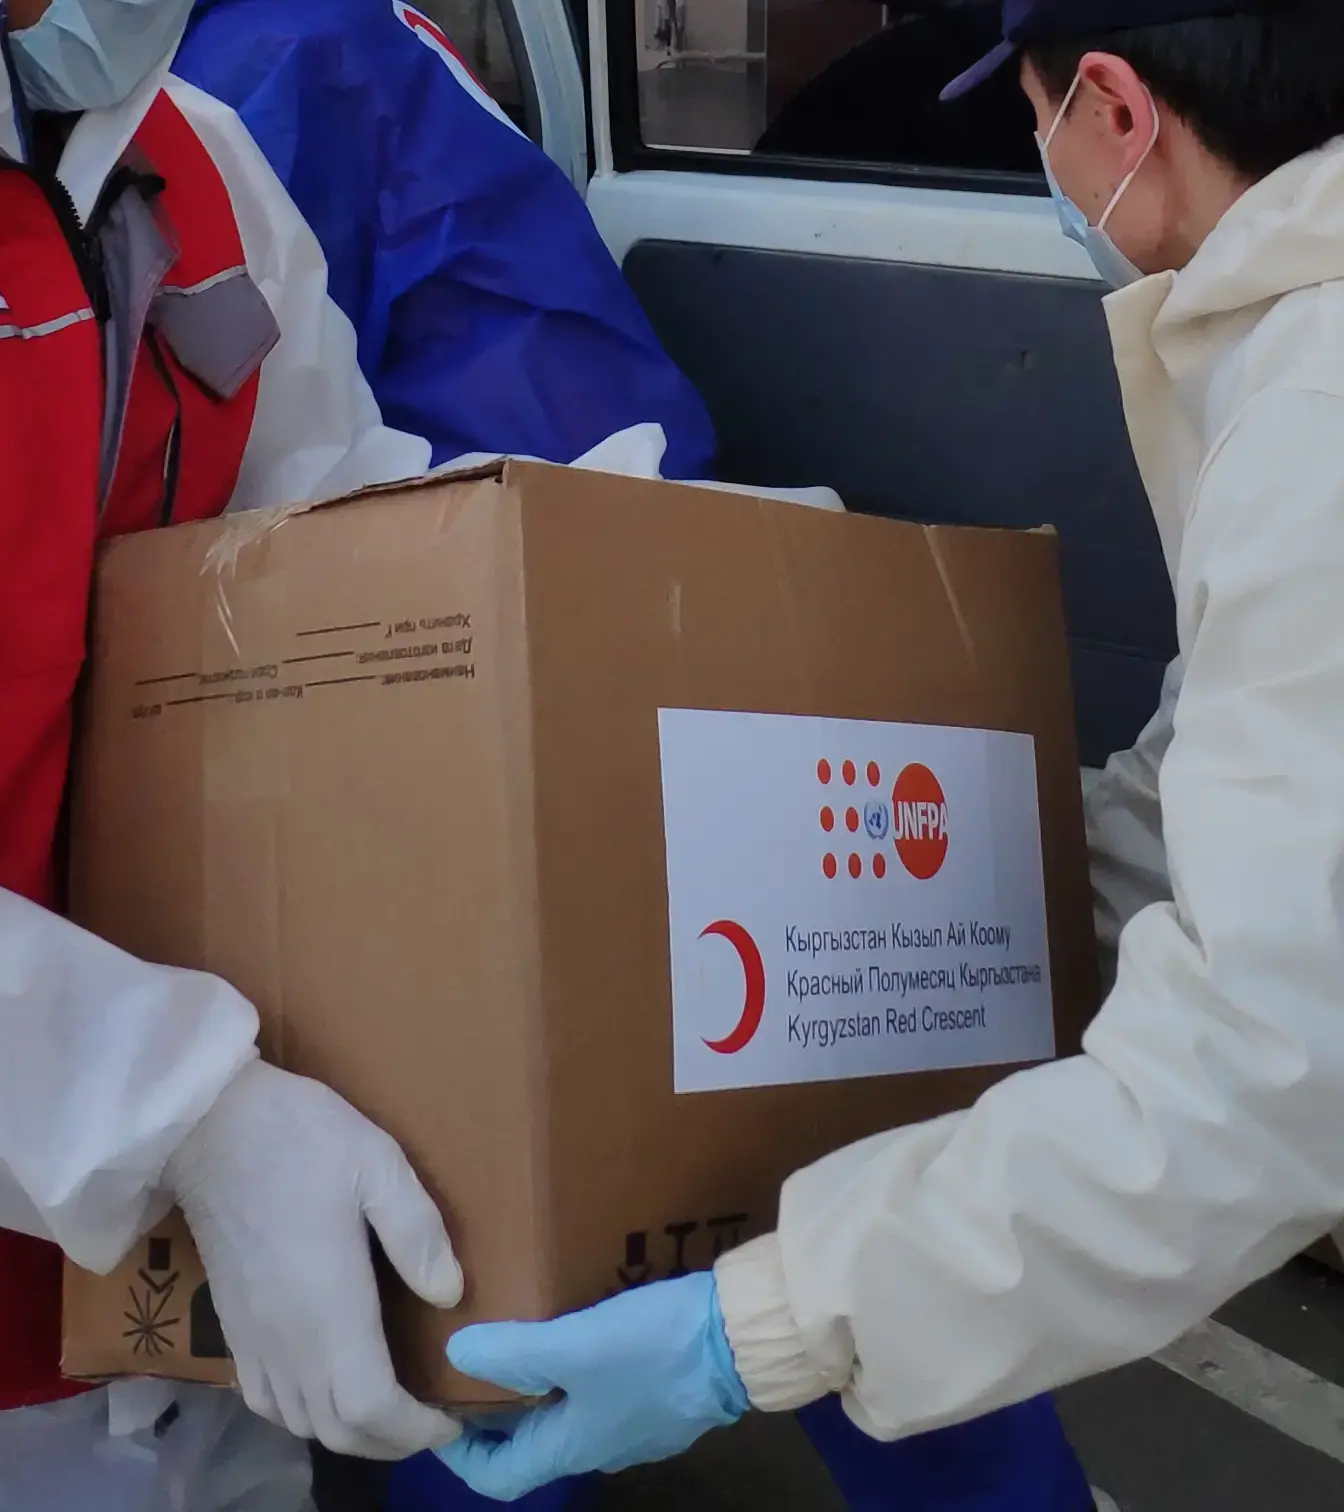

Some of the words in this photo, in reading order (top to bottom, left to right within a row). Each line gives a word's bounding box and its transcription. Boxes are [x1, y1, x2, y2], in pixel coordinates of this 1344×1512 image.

[891, 800, 949, 842] UNFPA
[785, 924, 887, 960] Кыргызстан
[890, 921, 943, 950] Кызыл
[946, 920, 966, 947] Ай
[969, 919, 1011, 951] Коому
[786, 967, 864, 1003] Красный
[868, 965, 956, 998] Полумесяц
[958, 962, 1042, 992] Кыргызстана
[787, 1009, 881, 1048] Kyrgyzstan
[885, 1006, 917, 1035] Red
[921, 1003, 986, 1031] Crescent
